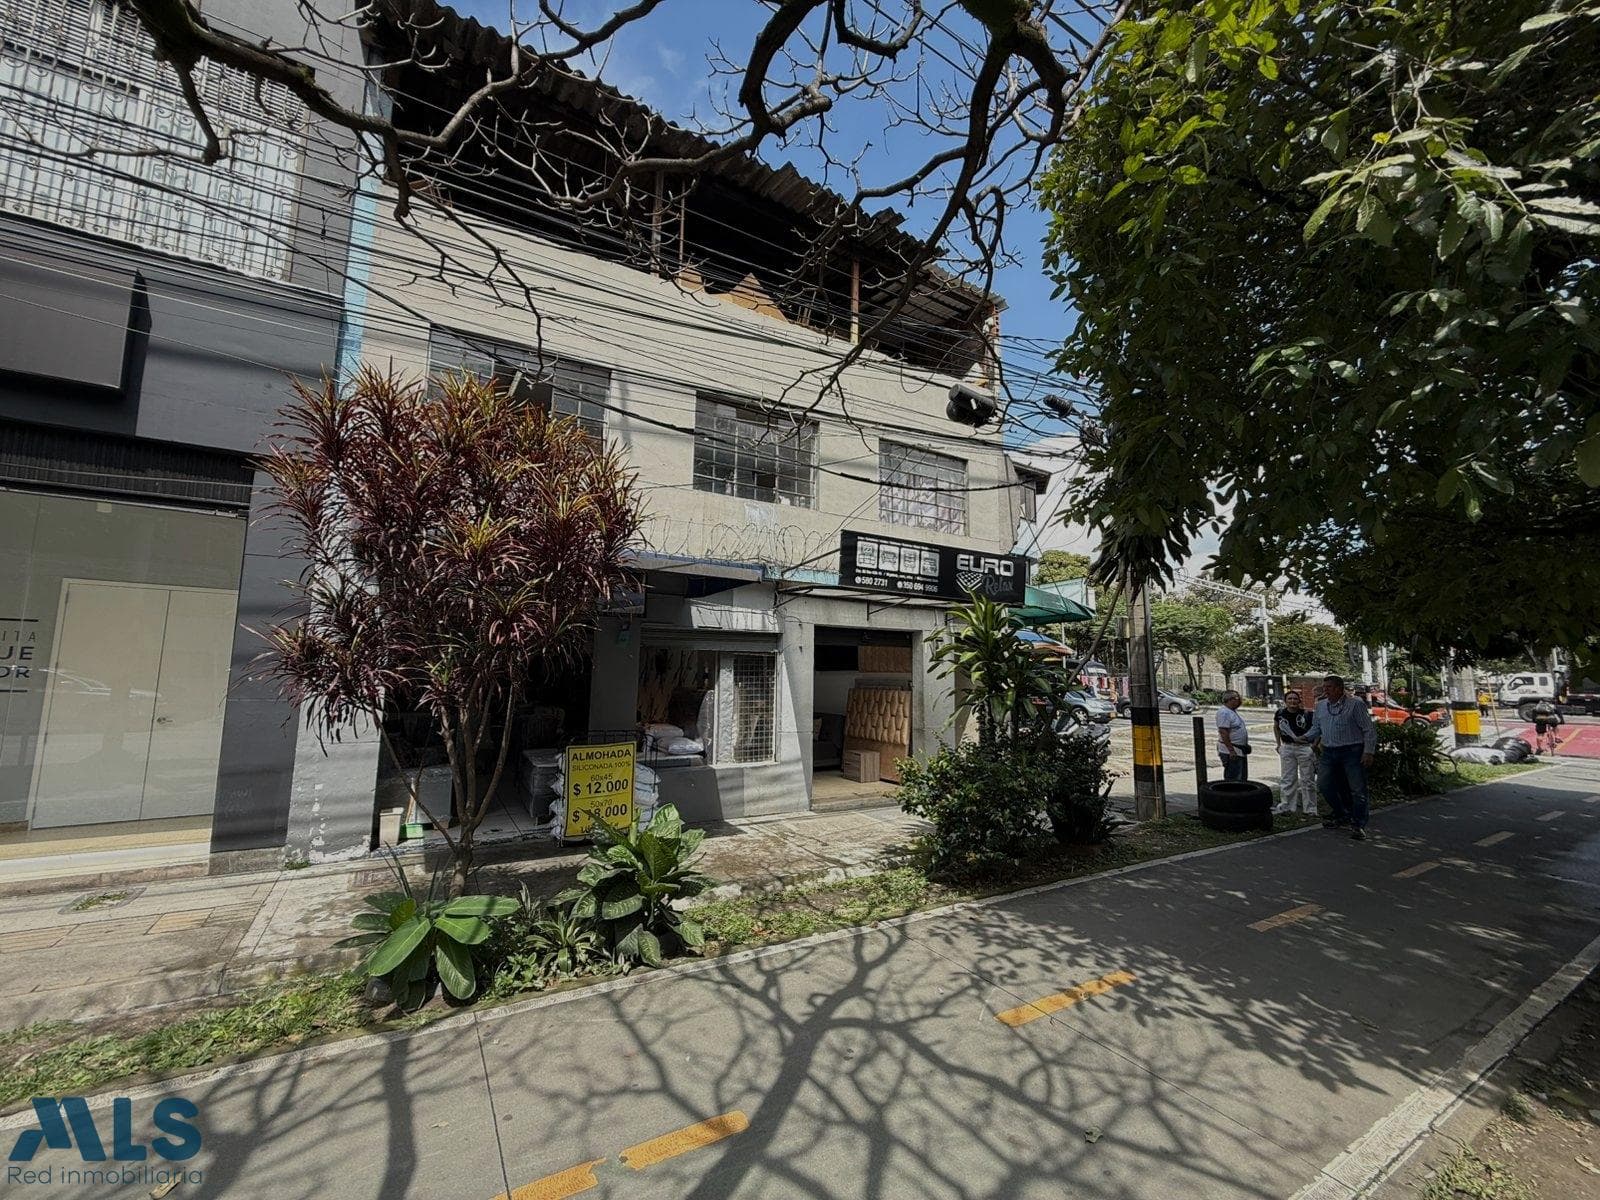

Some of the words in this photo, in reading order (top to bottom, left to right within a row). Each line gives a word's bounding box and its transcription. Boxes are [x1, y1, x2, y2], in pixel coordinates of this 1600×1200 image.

[956, 553, 1014, 577] EURO
[982, 574, 1014, 596] Relax
[571, 749, 632, 762] ALMOHADA
[572, 763, 613, 772] SILICONADA
[573, 782, 581, 797] $
[586, 778, 629, 795] 12.000
[572, 809, 580, 824] $
